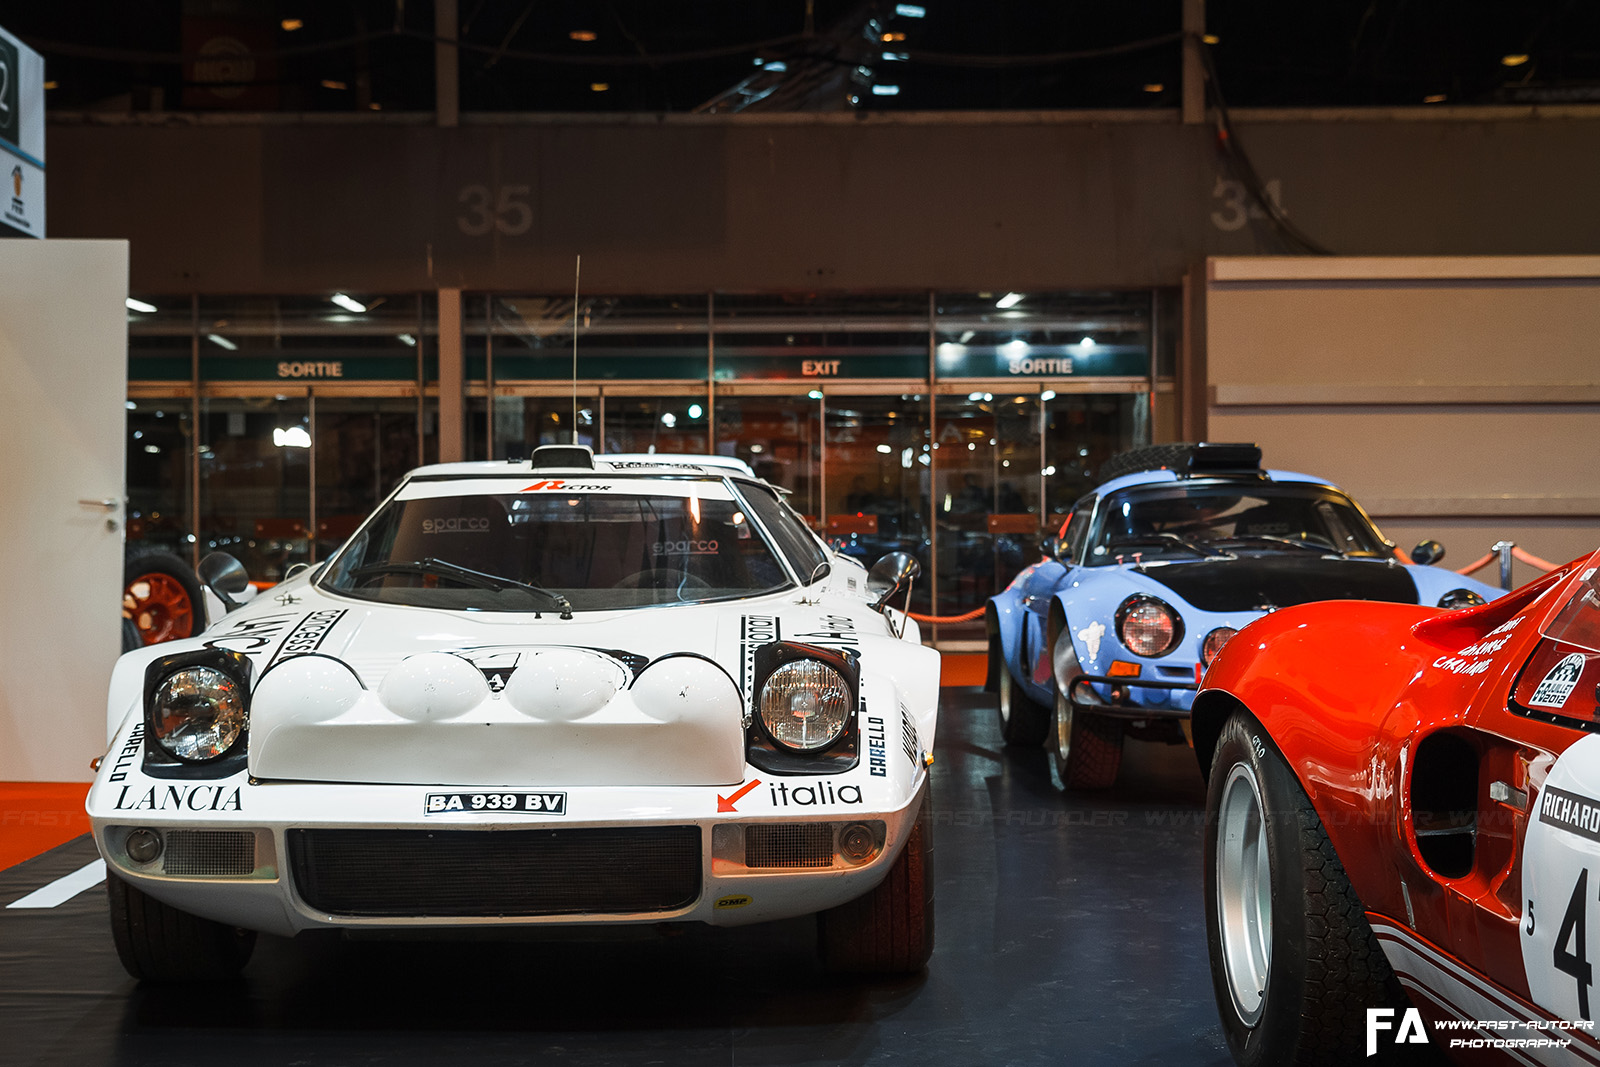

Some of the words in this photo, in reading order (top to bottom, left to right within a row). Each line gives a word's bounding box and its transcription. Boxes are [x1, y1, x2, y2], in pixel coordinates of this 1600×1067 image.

[457, 184, 533, 236] 35
[277, 360, 343, 377] SORTIE
[802, 360, 840, 375] EXIT
[1008, 358, 1073, 374] SORTIE
[422, 517, 490, 534] sparco
[652, 539, 719, 555] sparco
[1542, 694, 1567, 704] 2012
[109, 722, 145, 783] CARELLO
[868, 716, 887, 777] CARELLO
[113, 785, 243, 811] LANCIA
[770, 781, 863, 806] italia
[429, 795, 464, 811] BA
[471, 794, 517, 810] 939
[525, 795, 562, 810] BV
[718, 898, 748, 907] OMP
[1526, 899, 1536, 936] 5
